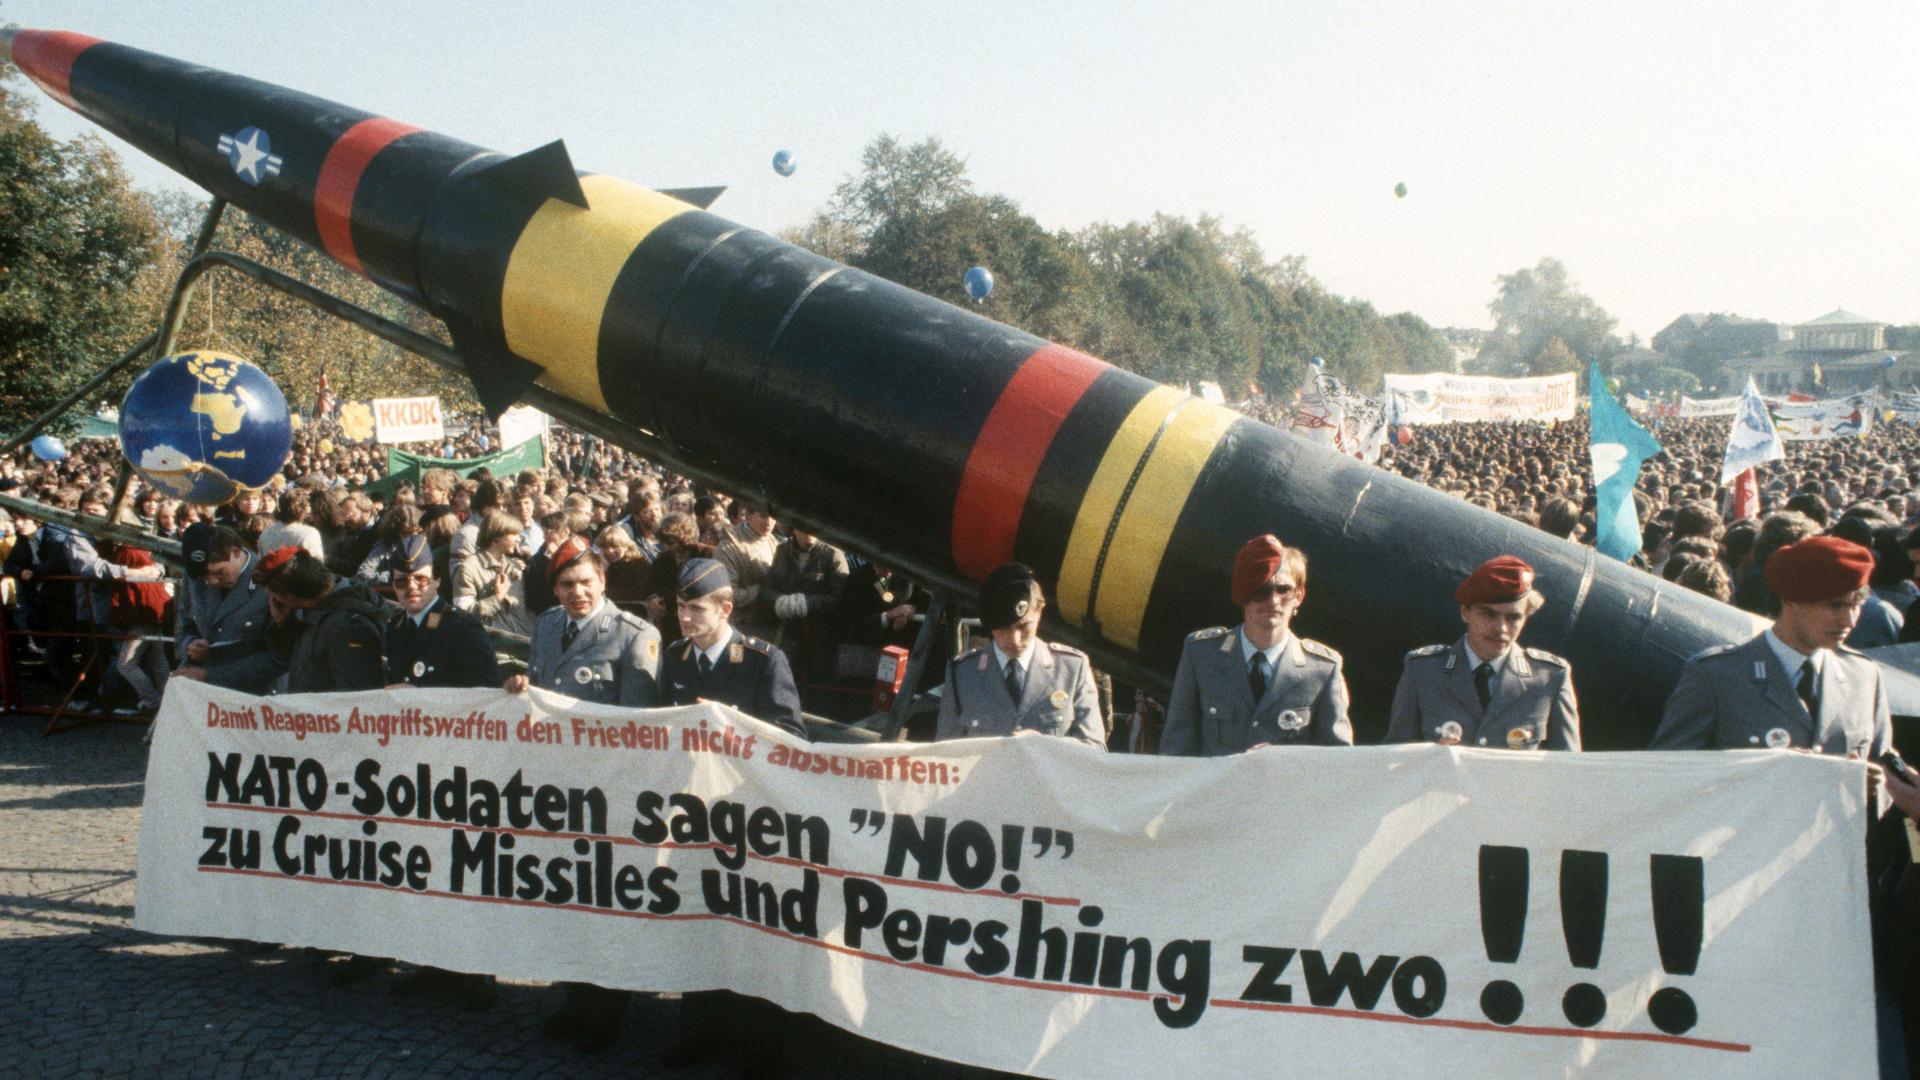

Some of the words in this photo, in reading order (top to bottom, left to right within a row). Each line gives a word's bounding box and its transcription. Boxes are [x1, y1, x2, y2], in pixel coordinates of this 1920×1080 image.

[207, 702, 258, 731] Damit
[260, 704, 341, 740] Reagans
[347, 707, 507, 747] Angriffswaffen
[517, 714, 562, 744] den
[571, 717, 669, 751] Frieden
[682, 720, 756, 760] nicht
[205, 751, 608, 835] NATO-Soldaten
[632, 790, 829, 870] sagen
[199, 826, 260, 870] zu
[273, 815, 431, 890] Cruise
[451, 829, 681, 915] Missiles
[702, 868, 820, 938] und
[843, 877, 1211, 1028] Pershing
[1239, 944, 1447, 1018] zwo
